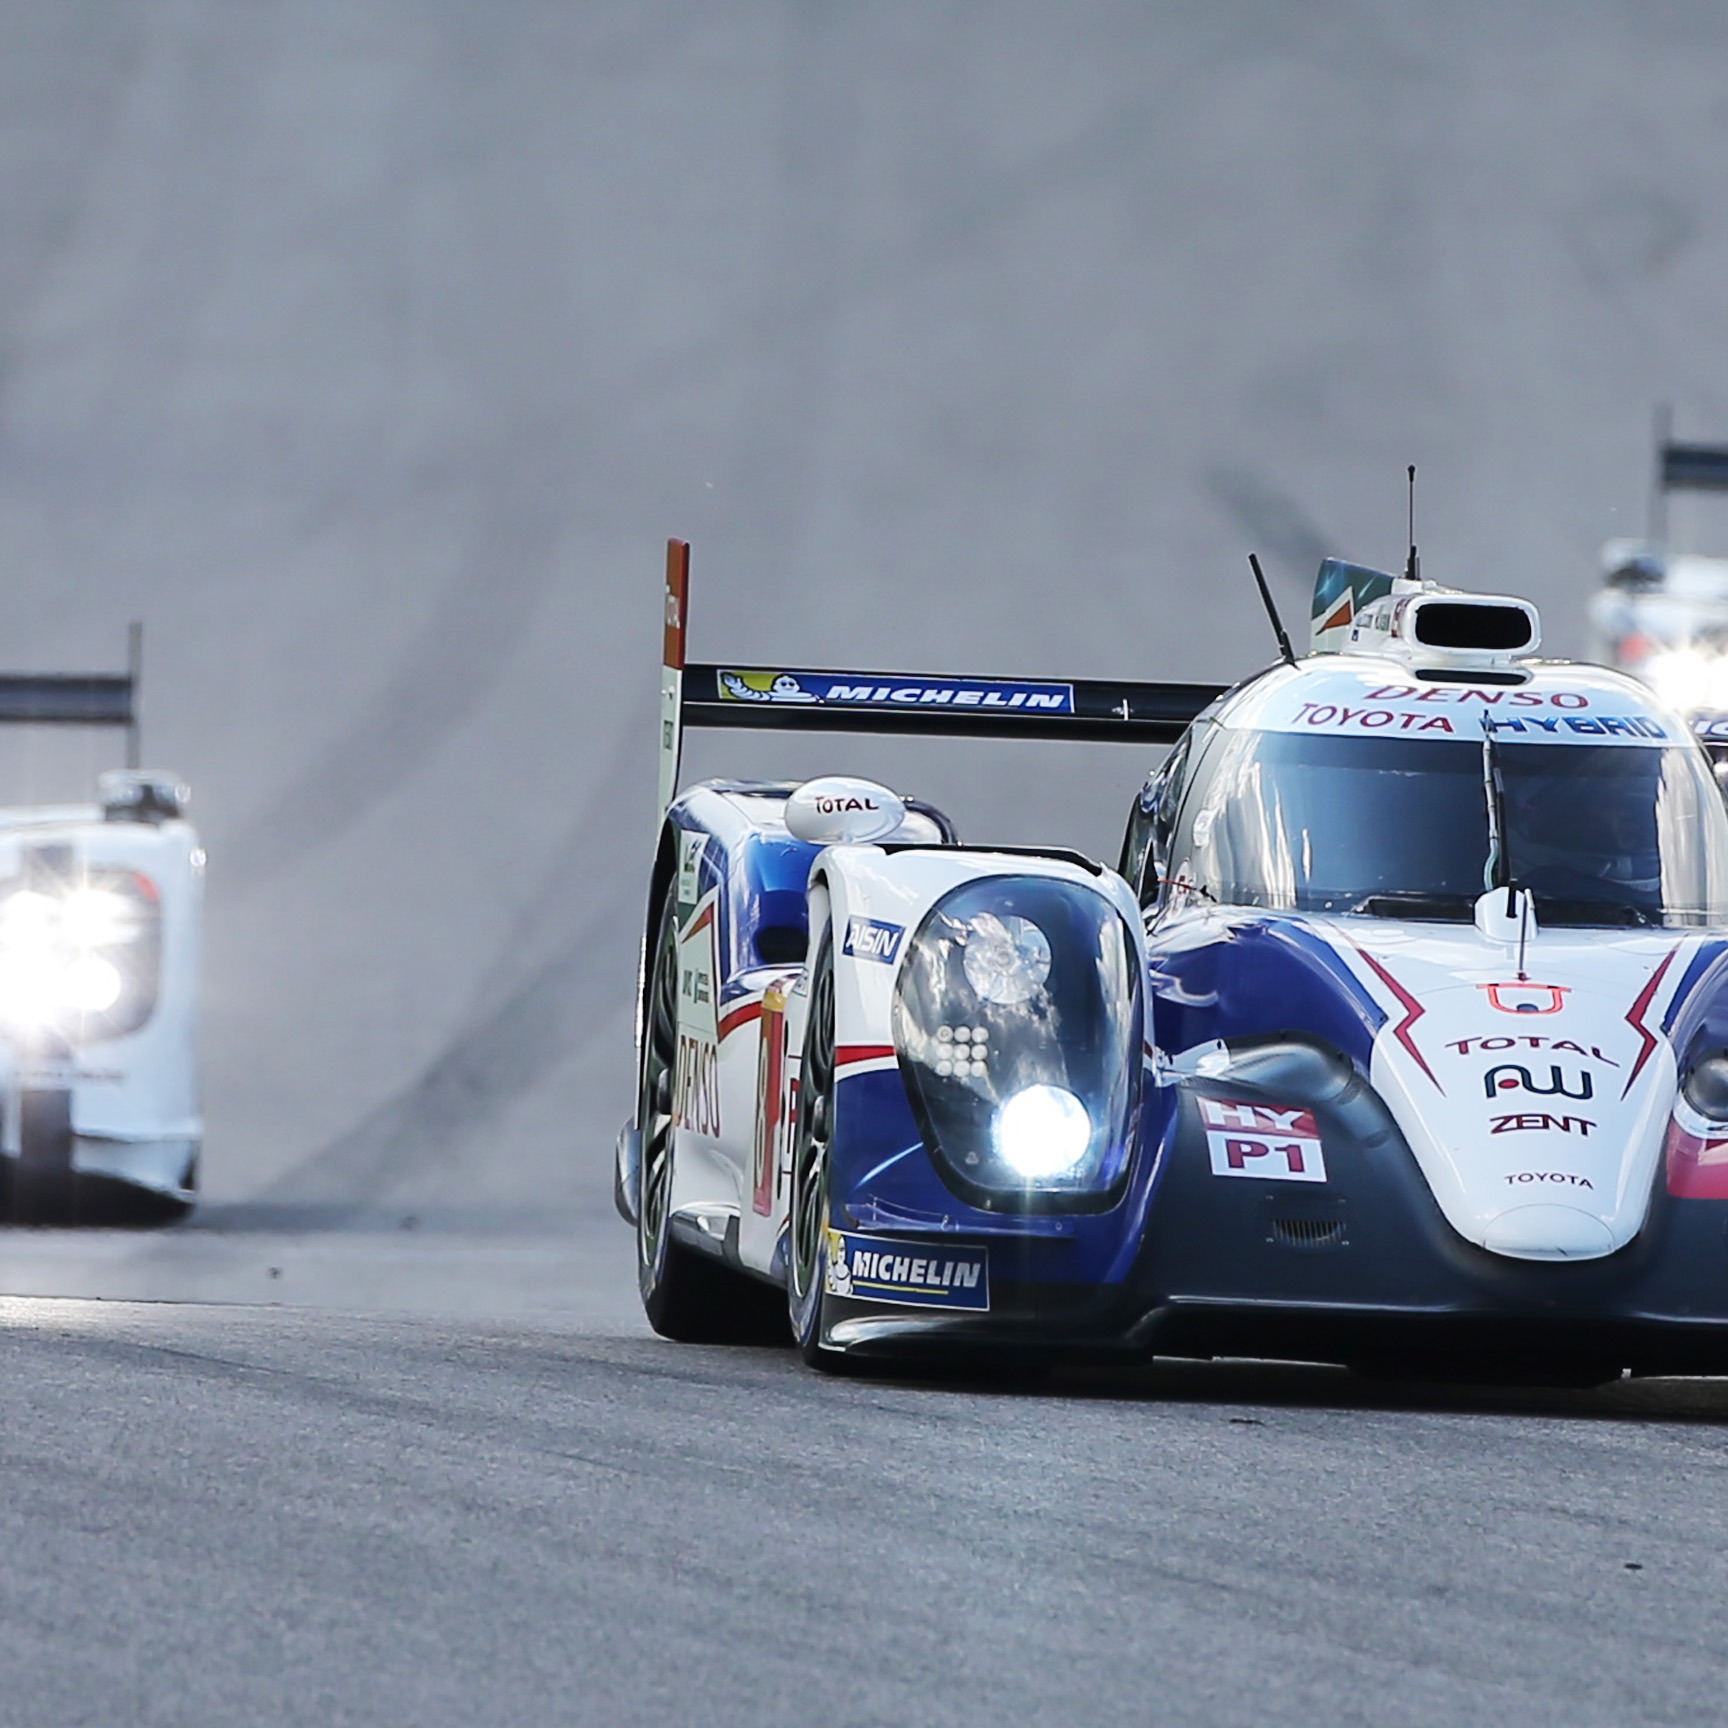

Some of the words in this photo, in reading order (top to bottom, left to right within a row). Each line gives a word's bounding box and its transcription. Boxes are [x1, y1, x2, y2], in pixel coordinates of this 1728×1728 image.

[826, 685, 1065, 708] MICHELIN
[1364, 683, 1590, 710] DENSO
[1291, 703, 1455, 733] TOYOTA
[1480, 715, 1667, 740] HYBRID
[815, 796, 879, 814] TOTAL
[845, 923, 899, 957] AISIN
[1445, 1036, 1620, 1068] TOTAL
[1205, 1100, 1305, 1131] HY
[1489, 1113, 1597, 1137] ZENT
[1225, 1139, 1305, 1173] P1
[1505, 1173, 1594, 1190] TOYOTA
[852, 1250, 981, 1288] MICHELIN
